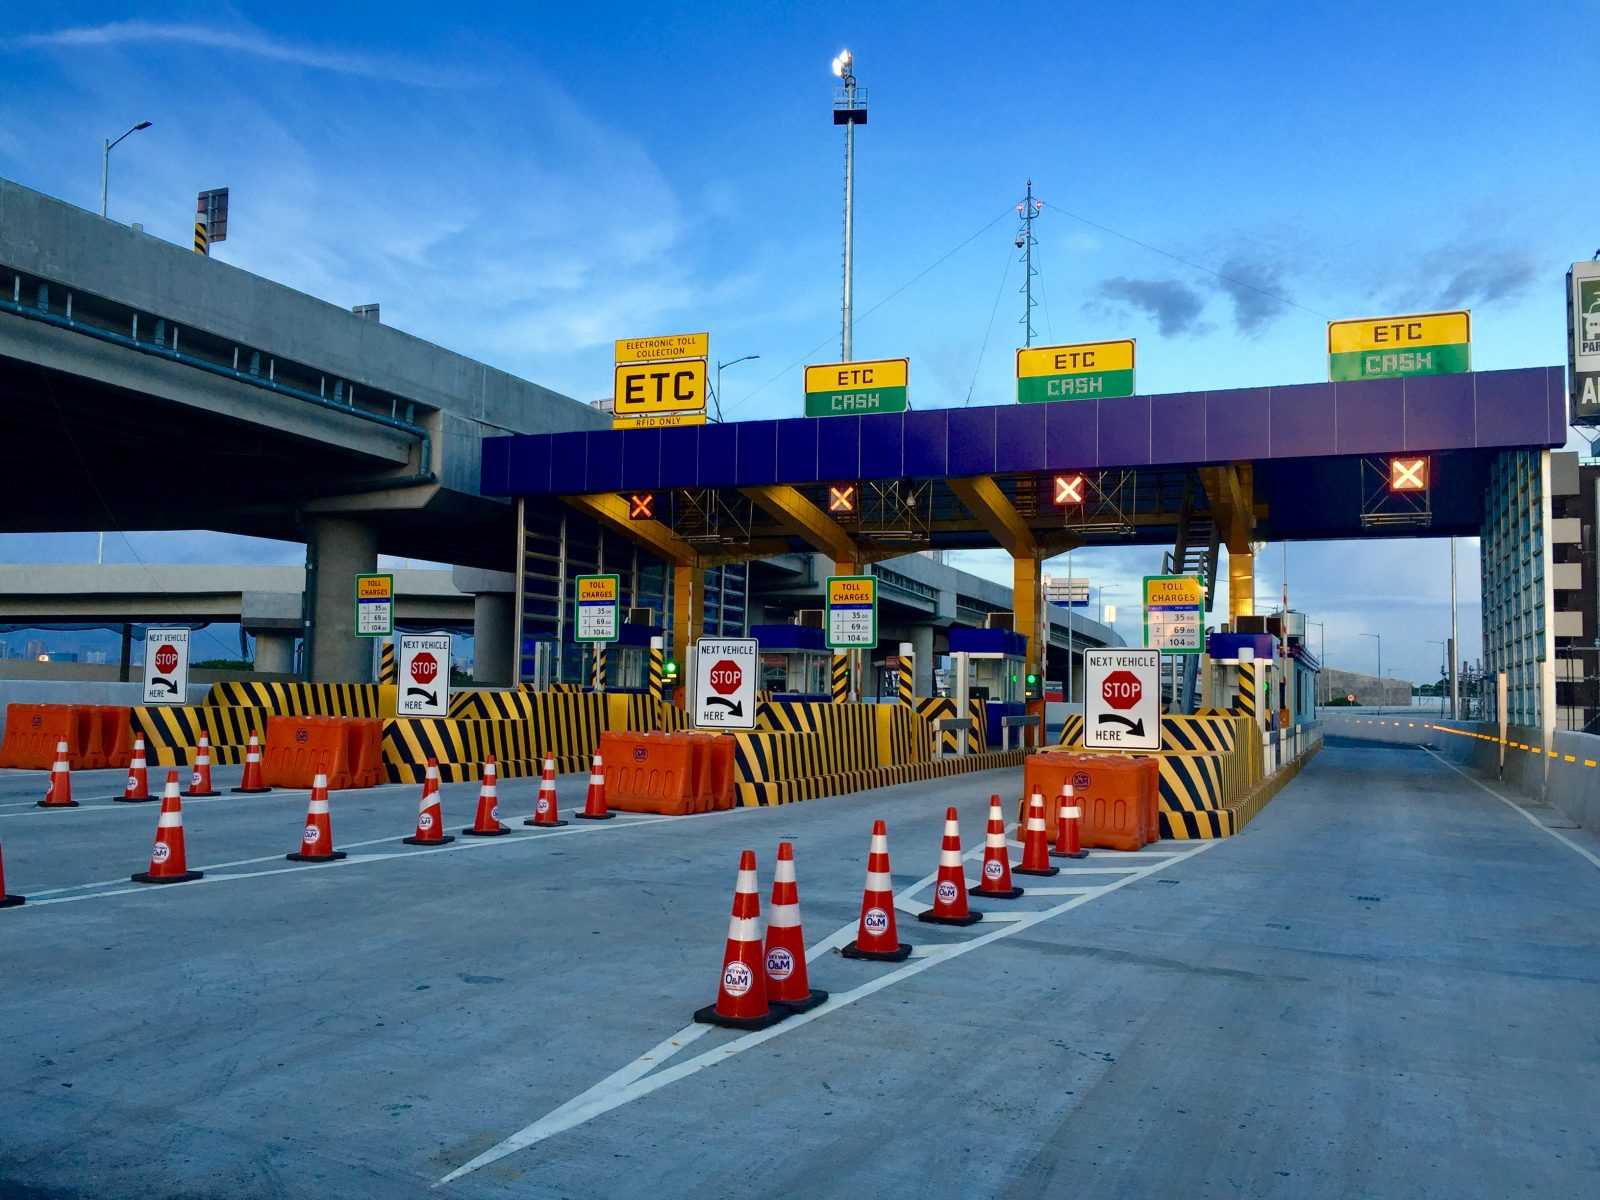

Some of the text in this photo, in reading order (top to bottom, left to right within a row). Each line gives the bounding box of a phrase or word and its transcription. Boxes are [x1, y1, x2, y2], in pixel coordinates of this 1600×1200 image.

[1374, 322, 1422, 342] ETC
[626, 340, 674, 350] ELECTRONIC
[636, 348, 685, 358] COLLECTION
[1055, 352, 1095, 369] ETC
[1366, 352, 1432, 373] CASH
[838, 369, 874, 386] ETC
[625, 371, 694, 404] ETC
[1048, 376, 1102, 396] CASH
[832, 392, 880, 410] CASH
[404, 641, 448, 650] NEXT VEHICLE
[702, 646, 754, 654] NEXT VEHICLE
[156, 654, 178, 665] STOP
[1090, 657, 1156, 666] NEXT VEHICLE
[412, 662, 437, 674] STOP
[712, 670, 740, 684] STOP
[1104, 682, 1140, 698] STOP
[405, 701, 422, 709] HERE
[704, 712, 724, 720] HERE
[1096, 730, 1122, 740] HERE
[940, 888, 954, 896] O&M
[866, 918, 886, 927] O&M
[768, 960, 790, 970] O&M
[726, 974, 748, 986] O&M
